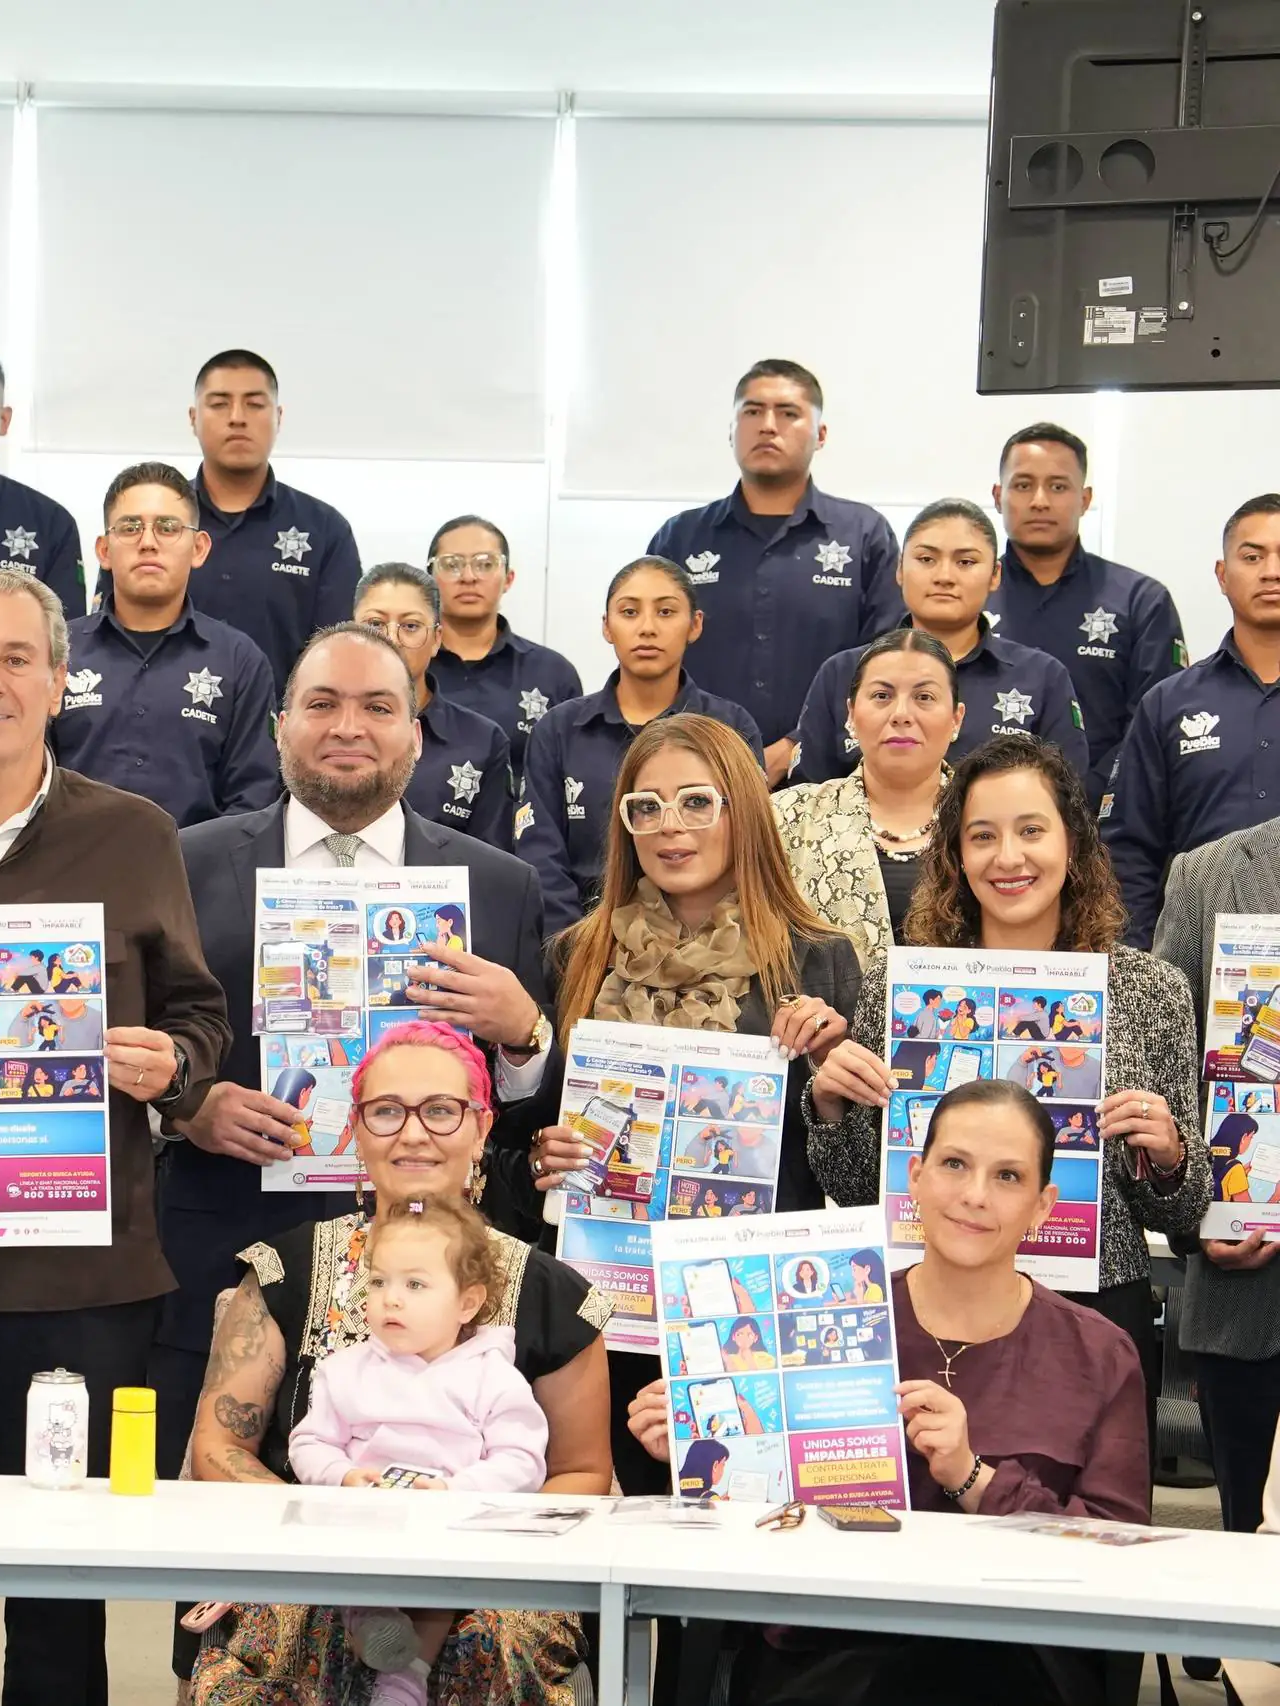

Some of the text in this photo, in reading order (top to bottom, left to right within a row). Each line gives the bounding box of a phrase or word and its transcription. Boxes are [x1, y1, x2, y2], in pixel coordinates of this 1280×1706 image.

[271, 562, 310, 577] CADETE
[812, 575, 852, 586] CADETE
[1077, 646, 1116, 658] CADETE
[181, 708, 217, 724] CADETE
[8, 1064, 26, 1072] HOTEL
[680, 1182, 698, 1191] HOTEL
[24, 1191, 44, 1199] 800
[48, 1191, 73, 1199] 5533
[628, 1235, 636, 1243] El
[625, 1246, 646, 1254] trata
[614, 1271, 648, 1281] SOMOS
[621, 1294, 646, 1302] TRATA
[803, 1435, 887, 1450] UNIDAS SOMOS
[804, 1446, 888, 1462] IMPARABLES
[806, 1461, 888, 1473] CONTRA LA TRATA
[682, 1479, 700, 1487] PERO
[814, 1473, 878, 1484] DE PERSONAS
